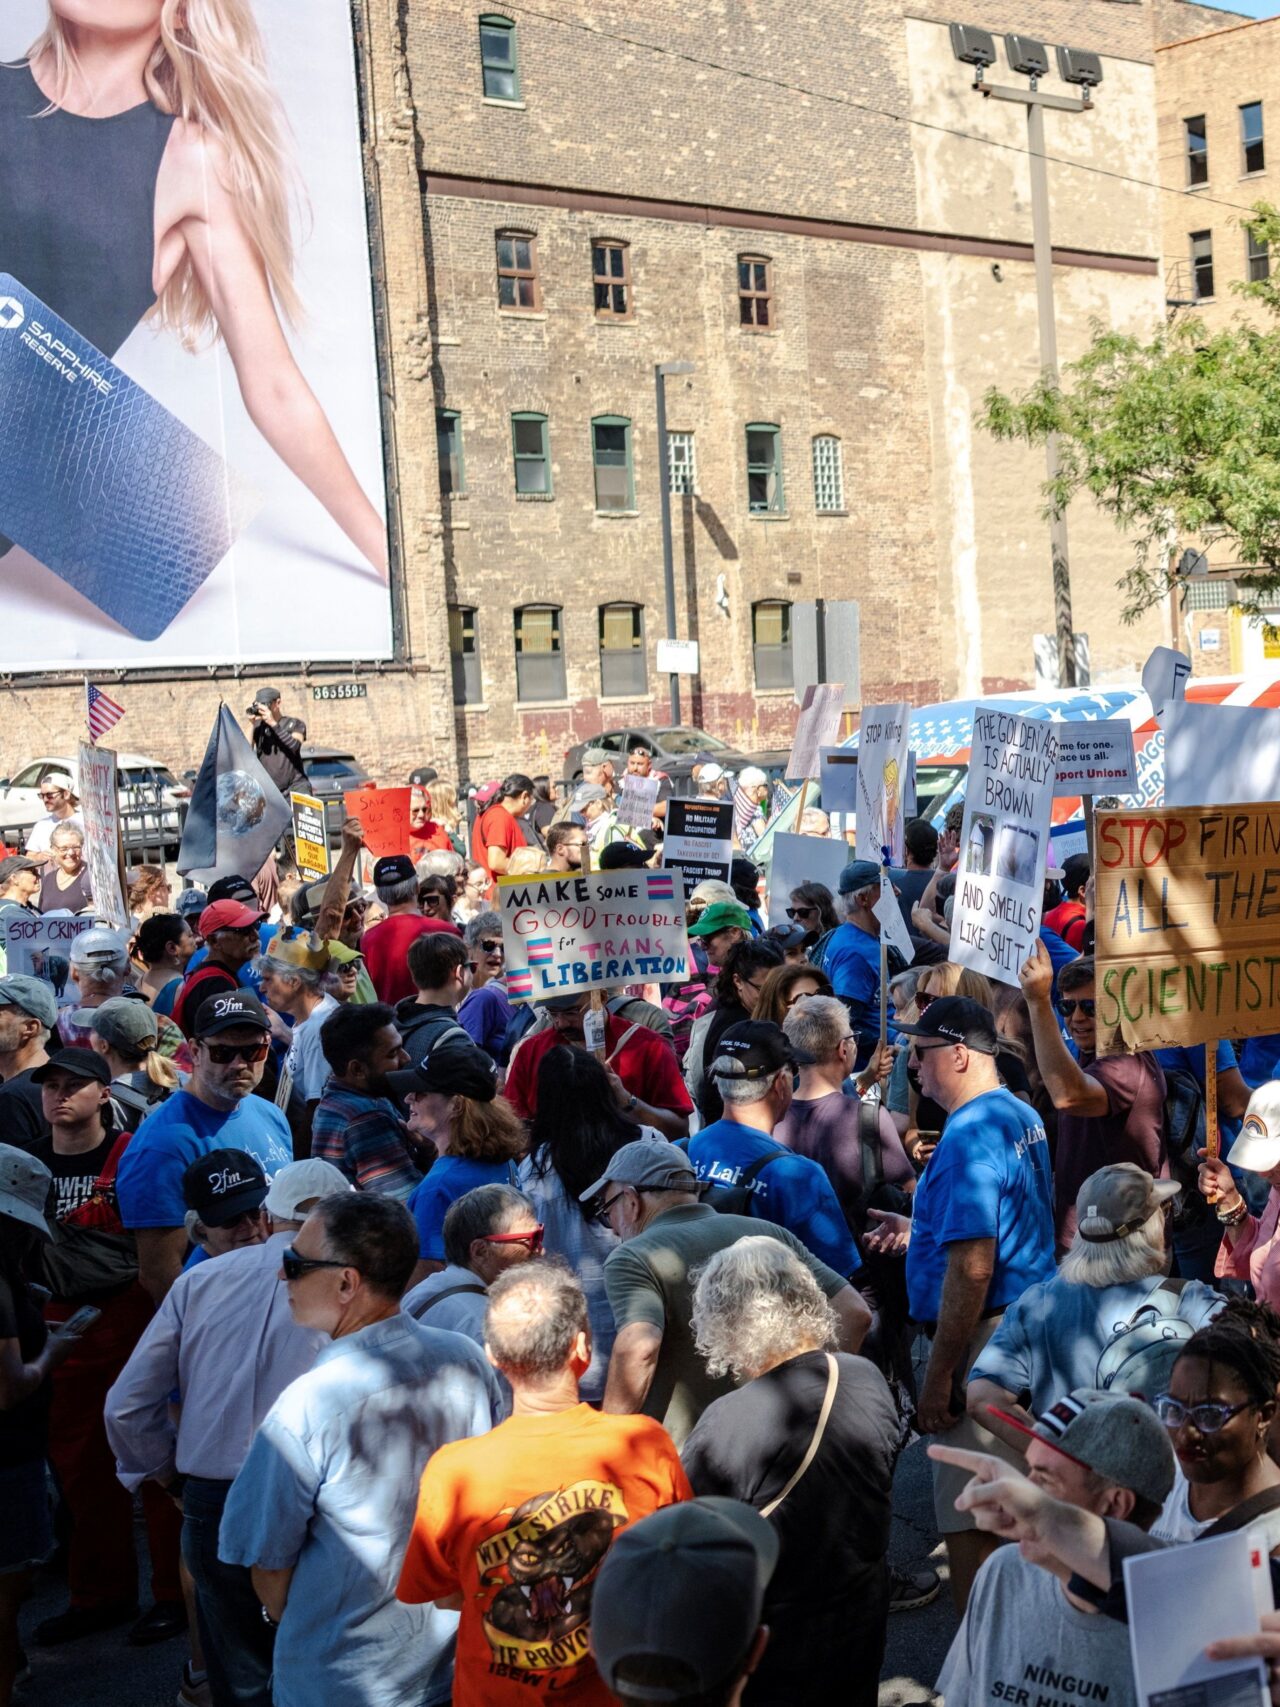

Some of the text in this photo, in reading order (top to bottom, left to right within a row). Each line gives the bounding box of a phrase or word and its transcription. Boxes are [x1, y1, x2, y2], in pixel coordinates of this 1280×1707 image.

[20, 331, 78, 383] RESERVE
[28, 320, 113, 396] SAPPHIRE
[866, 724, 882, 744] STOP
[975, 714, 996, 741] THE
[1041, 728, 1059, 765] AGE
[1077, 742, 1090, 750] for
[1093, 742, 1114, 750] one.
[983, 745, 999, 770] IS
[1000, 750, 1051, 785] ACTUALLY
[1080, 753, 1091, 761] us
[1094, 751, 1110, 761] all.
[1087, 768, 1127, 779] Unions
[985, 777, 1034, 819] BROWN
[1100, 817, 1187, 869] STOP
[506, 878, 639, 908] MAKE SOME
[961, 880, 1036, 934] AND SMELLS
[1112, 877, 1189, 939] ALL
[9, 921, 44, 940] STOP
[512, 907, 683, 934] GOOD TROUBLE
[960, 920, 986, 951] LIKE
[557, 937, 665, 960] for TRANS
[541, 957, 686, 989] LIBERATION
[1026, 1123, 1047, 1145] Lab
[479, 1487, 614, 1567] WILL STRIKE
[500, 1628, 588, 1668] IF PROVO
[488, 1662, 543, 1687] IBEW
[1024, 1663, 1110, 1701] NINGUN
[991, 1681, 1031, 1707] SER
